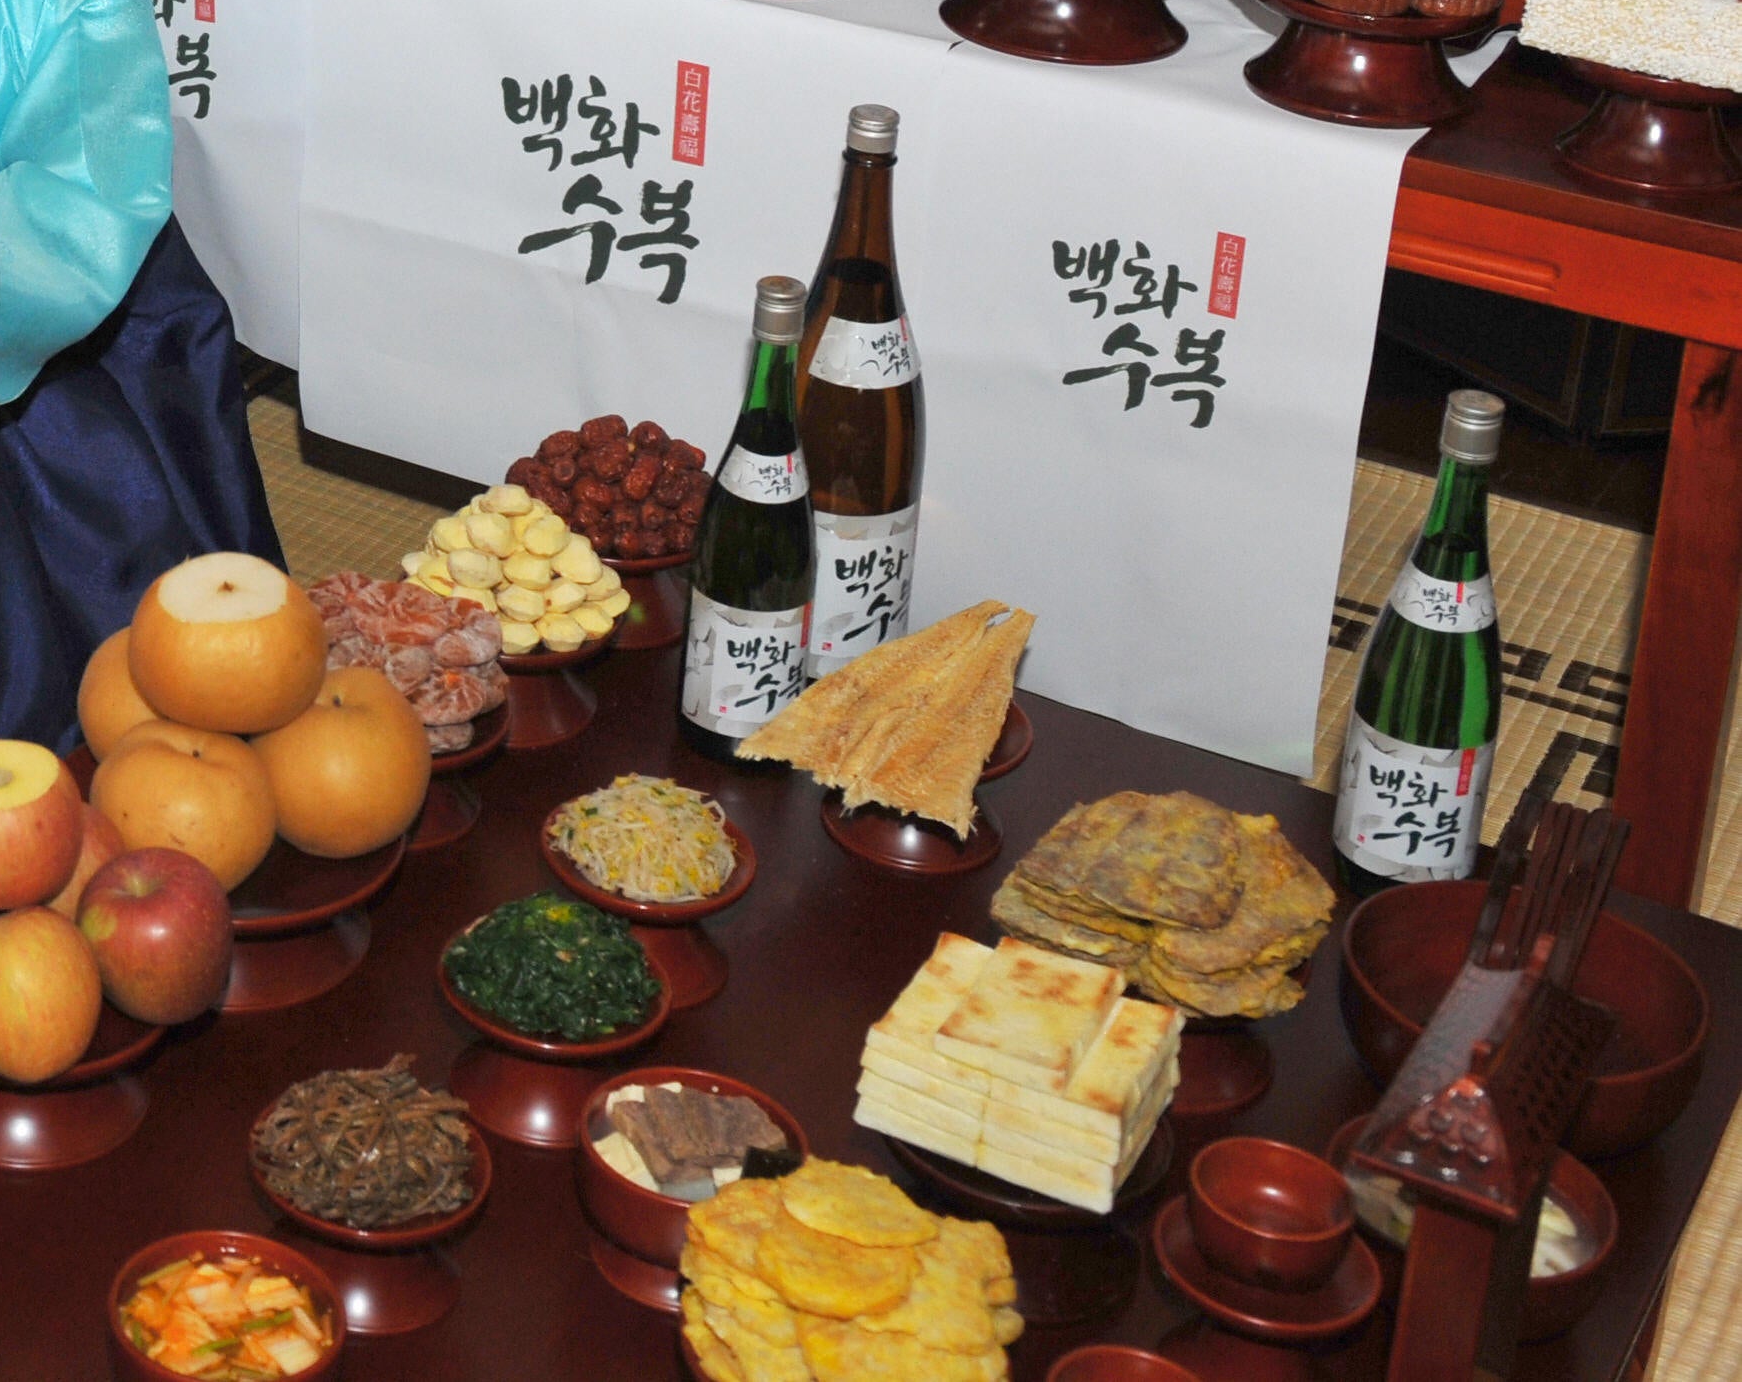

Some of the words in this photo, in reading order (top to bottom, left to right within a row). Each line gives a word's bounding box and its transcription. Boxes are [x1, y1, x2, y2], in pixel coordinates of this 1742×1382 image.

[168, 33, 217, 119] 복
[501, 73, 660, 171] 백화
[676, 64, 705, 163] 白花壽福
[518, 174, 700, 304] 수복
[1052, 238, 1197, 320] 백화
[1211, 235, 1242, 316] 白花壽福
[871, 331, 901, 356] 백화
[883, 345, 911, 376] 수복
[1063, 322, 1226, 429] 수복
[759, 462, 784, 479] 백화
[764, 476, 792, 495] 수복
[835, 546, 909, 597] 백화
[1422, 586, 1454, 607] 백화
[1426, 603, 1459, 625] 수복
[727, 636, 796, 674] 백화
[1369, 764, 1449, 810] 백화
[1373, 807, 1462, 858] 수복
